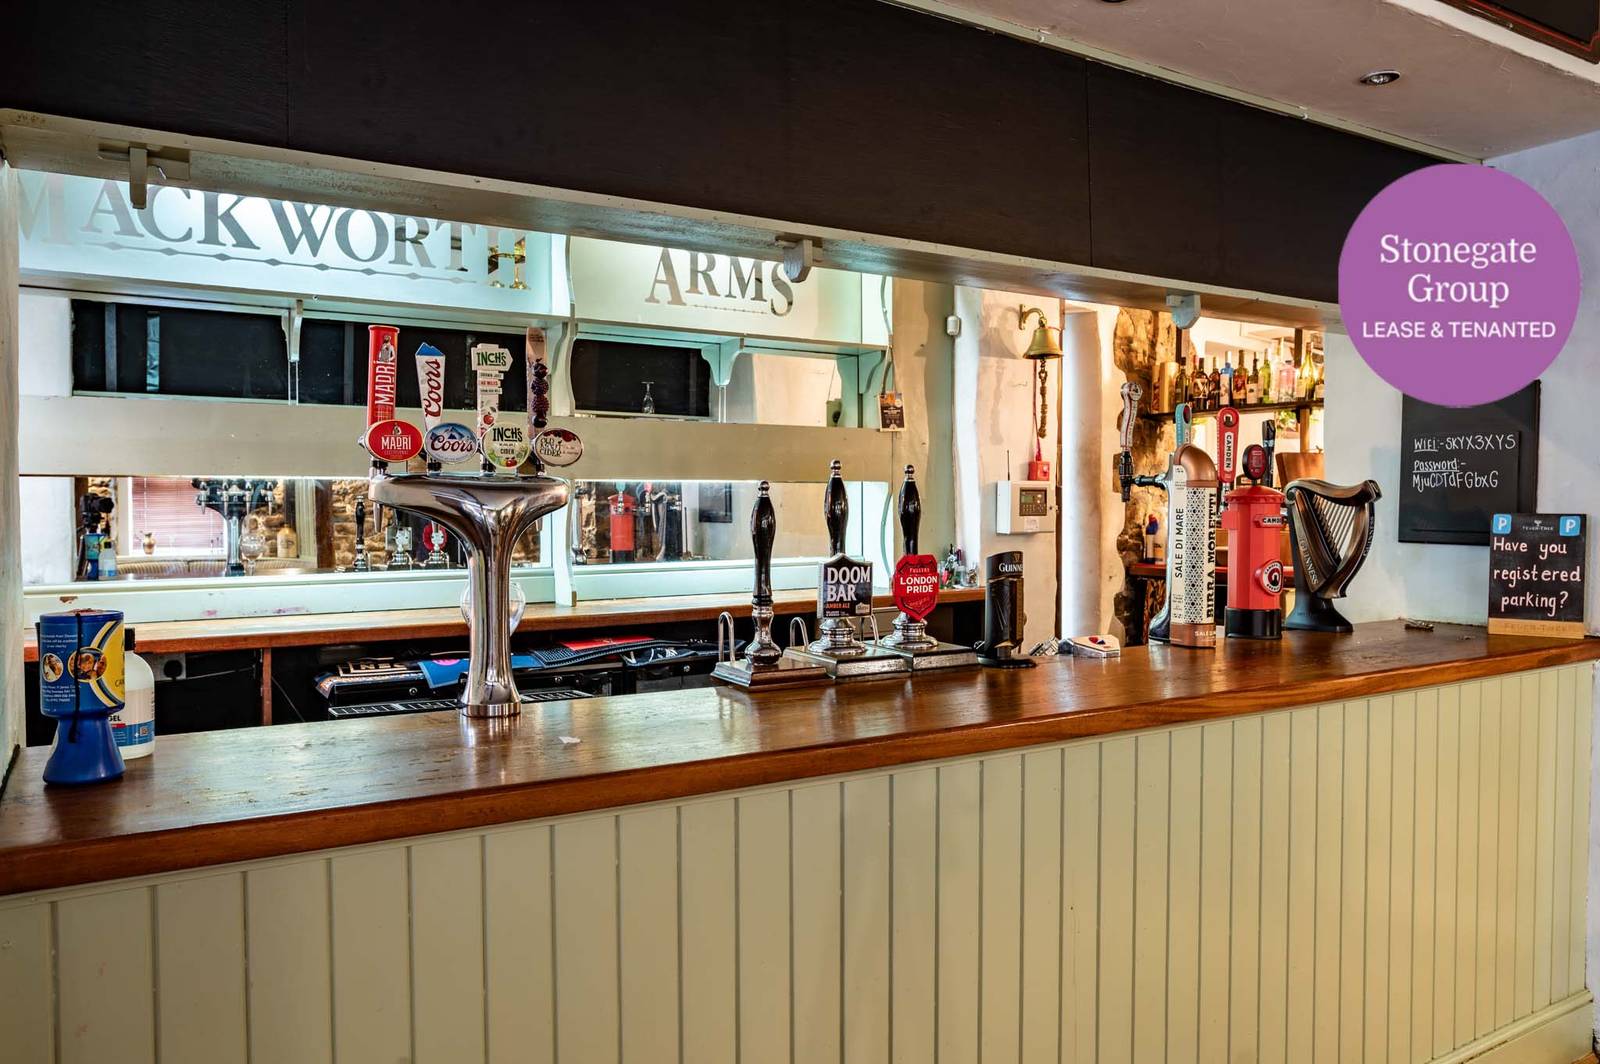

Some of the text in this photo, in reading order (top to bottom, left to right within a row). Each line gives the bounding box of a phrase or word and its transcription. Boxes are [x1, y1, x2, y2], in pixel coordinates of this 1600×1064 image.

[17, 168, 532, 292] MACKWORTH
[644, 246, 794, 317] ARMS
[424, 358, 442, 417] Coors
[430, 434, 474, 452] Coors
[1175, 508, 1184, 578] SALE DI MARE
[1493, 536, 1568, 560] Have you
[1206, 493, 1217, 619] BIRRA MORETTI
[827, 566, 871, 584] DOOM
[900, 576, 938, 585] LONDON
[1493, 564, 1582, 588] registered
[827, 584, 857, 602] BAR
[906, 585, 934, 594] PRIDE
